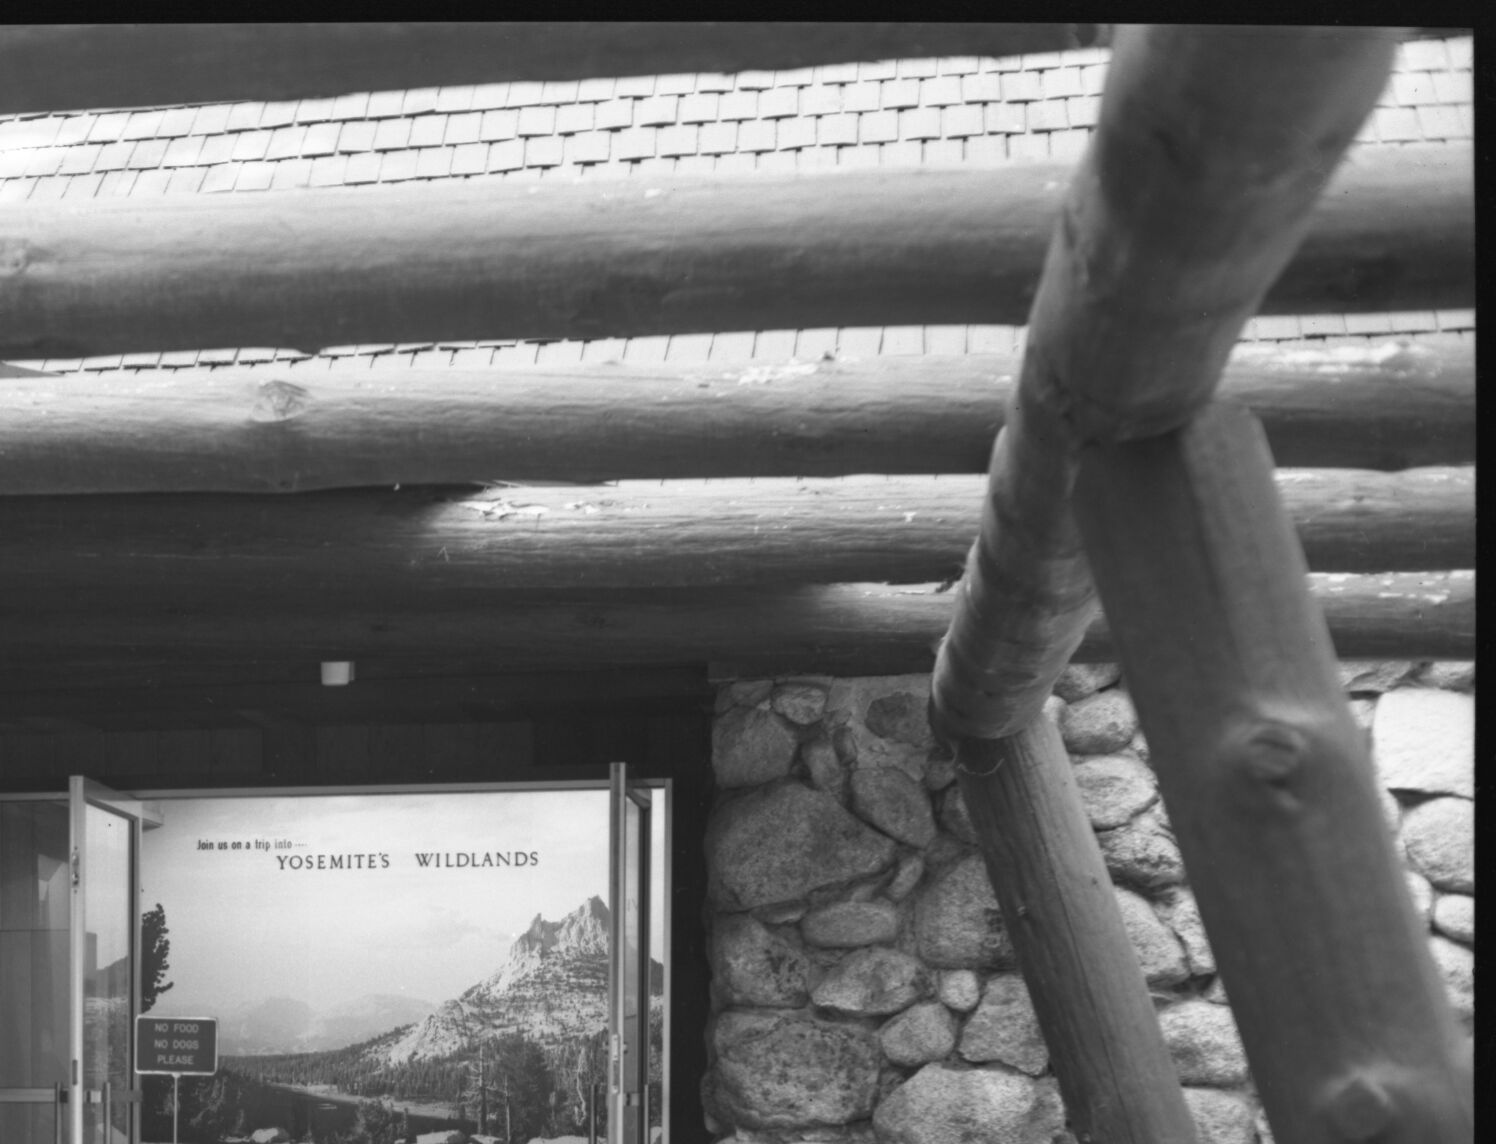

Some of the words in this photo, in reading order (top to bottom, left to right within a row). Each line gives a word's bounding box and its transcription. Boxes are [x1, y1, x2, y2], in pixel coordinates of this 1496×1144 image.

[196, 839, 214, 851] Join
[217, 841, 228, 850] us
[231, 841, 242, 850] on
[245, 841, 251, 850] a
[255, 839, 271, 852] trip
[276, 853, 390, 871] YOSEMITE'S
[415, 851, 540, 868] WILDLANDS
[154, 1023, 169, 1033] NO
[173, 1023, 200, 1034] FOOD
[154, 1039, 169, 1049] NO
[172, 1039, 200, 1050] DOGS
[157, 1054, 195, 1065] PLEASE
